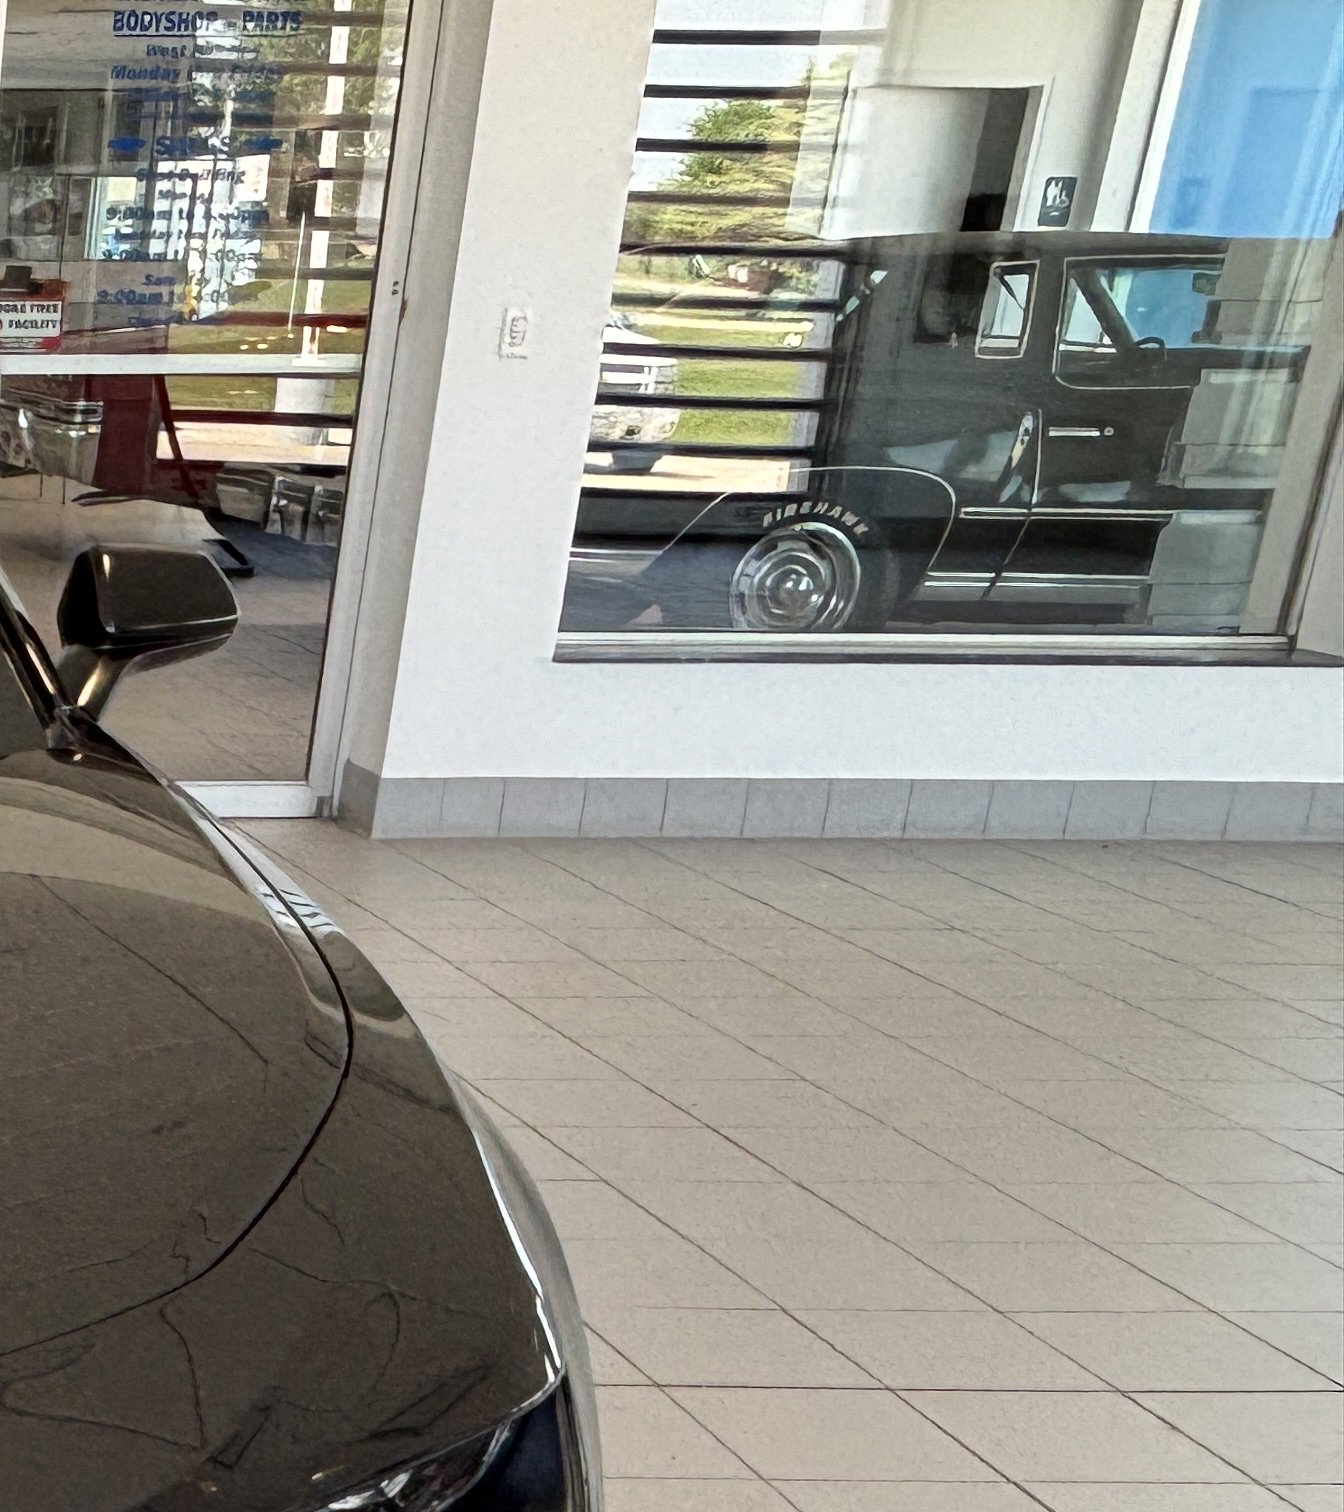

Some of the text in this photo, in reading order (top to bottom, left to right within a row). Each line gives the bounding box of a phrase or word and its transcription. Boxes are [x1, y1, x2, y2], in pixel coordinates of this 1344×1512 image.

[113, 10, 219, 32] BODYSHOP
[242, 10, 302, 32] PARTS
[30, 303, 60, 314] FREE
[8, 319, 58, 329] FACILITY
